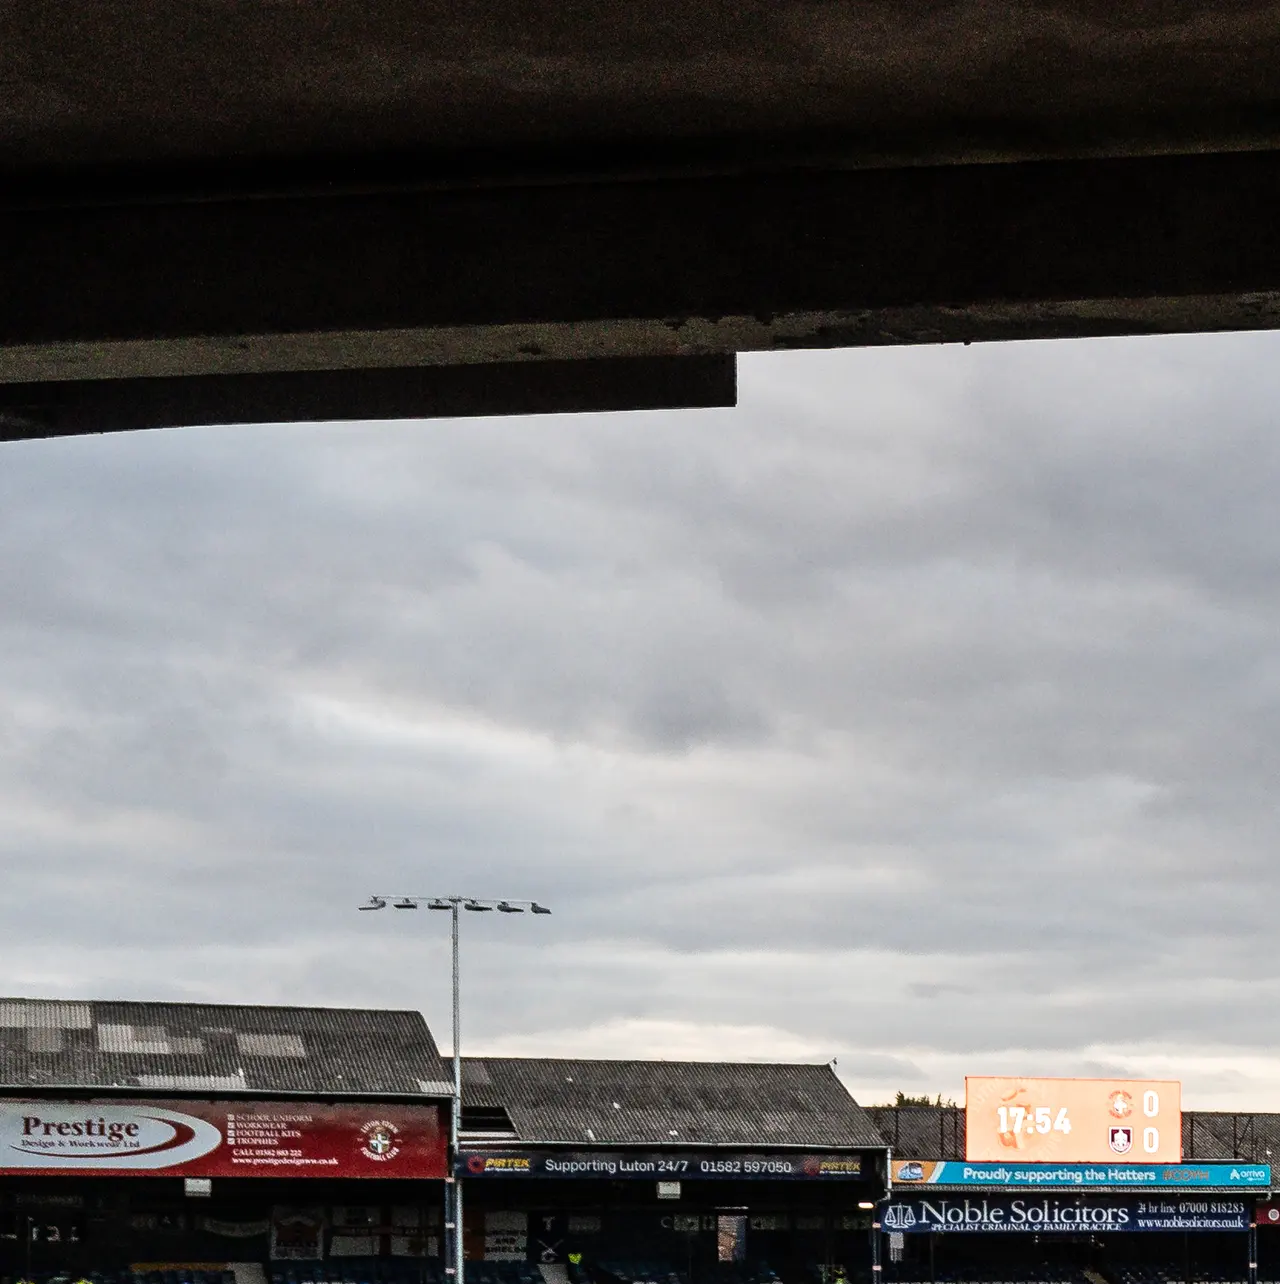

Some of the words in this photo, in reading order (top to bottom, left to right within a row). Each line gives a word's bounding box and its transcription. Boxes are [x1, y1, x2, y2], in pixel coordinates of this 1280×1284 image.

[1143, 1090, 1160, 1118] 0
[236, 1114, 270, 1122] SCHOOL
[997, 1106, 1072, 1135] 17:54
[22, 1116, 139, 1141] Prestige
[236, 1122, 287, 1130] WORKWEAR
[236, 1130, 281, 1138] FOOTBALL
[281, 1130, 302, 1138] KITS
[236, 1138, 279, 1146] TROPHIES
[1143, 1127, 1160, 1154] 0
[232, 1149, 254, 1157] CALL
[545, 1158, 617, 1174] Supporting
[619, 1159, 656, 1172] Luton
[658, 1159, 690, 1172] 24/7
[700, 1160, 741, 1173] 01582
[744, 1160, 793, 1173] 597050
[963, 1167, 1013, 1183] Proudly
[1014, 1168, 1082, 1183] supporting
[1084, 1168, 1106, 1180] the
[1108, 1168, 1156, 1180] Hatters
[1240, 1170, 1265, 1178] arriva
[918, 1199, 1004, 1224] Noble
[1010, 1200, 1130, 1223] Solicitors
[1137, 1202, 1147, 1213] 24
[1148, 1202, 1160, 1213] hr
[1160, 1202, 1176, 1213] line
[1179, 1202, 1208, 1213] 07000
[1210, 1202, 1245, 1214] 818283
[931, 1223, 981, 1231] SPECIALIST
[981, 1223, 1031, 1231] CRIMINAL
[1043, 1223, 1078, 1231] FAMILY
[1078, 1223, 1122, 1231] PRACTICE
[1137, 1215, 1244, 1228] www.noblesolicitors.co.uk
